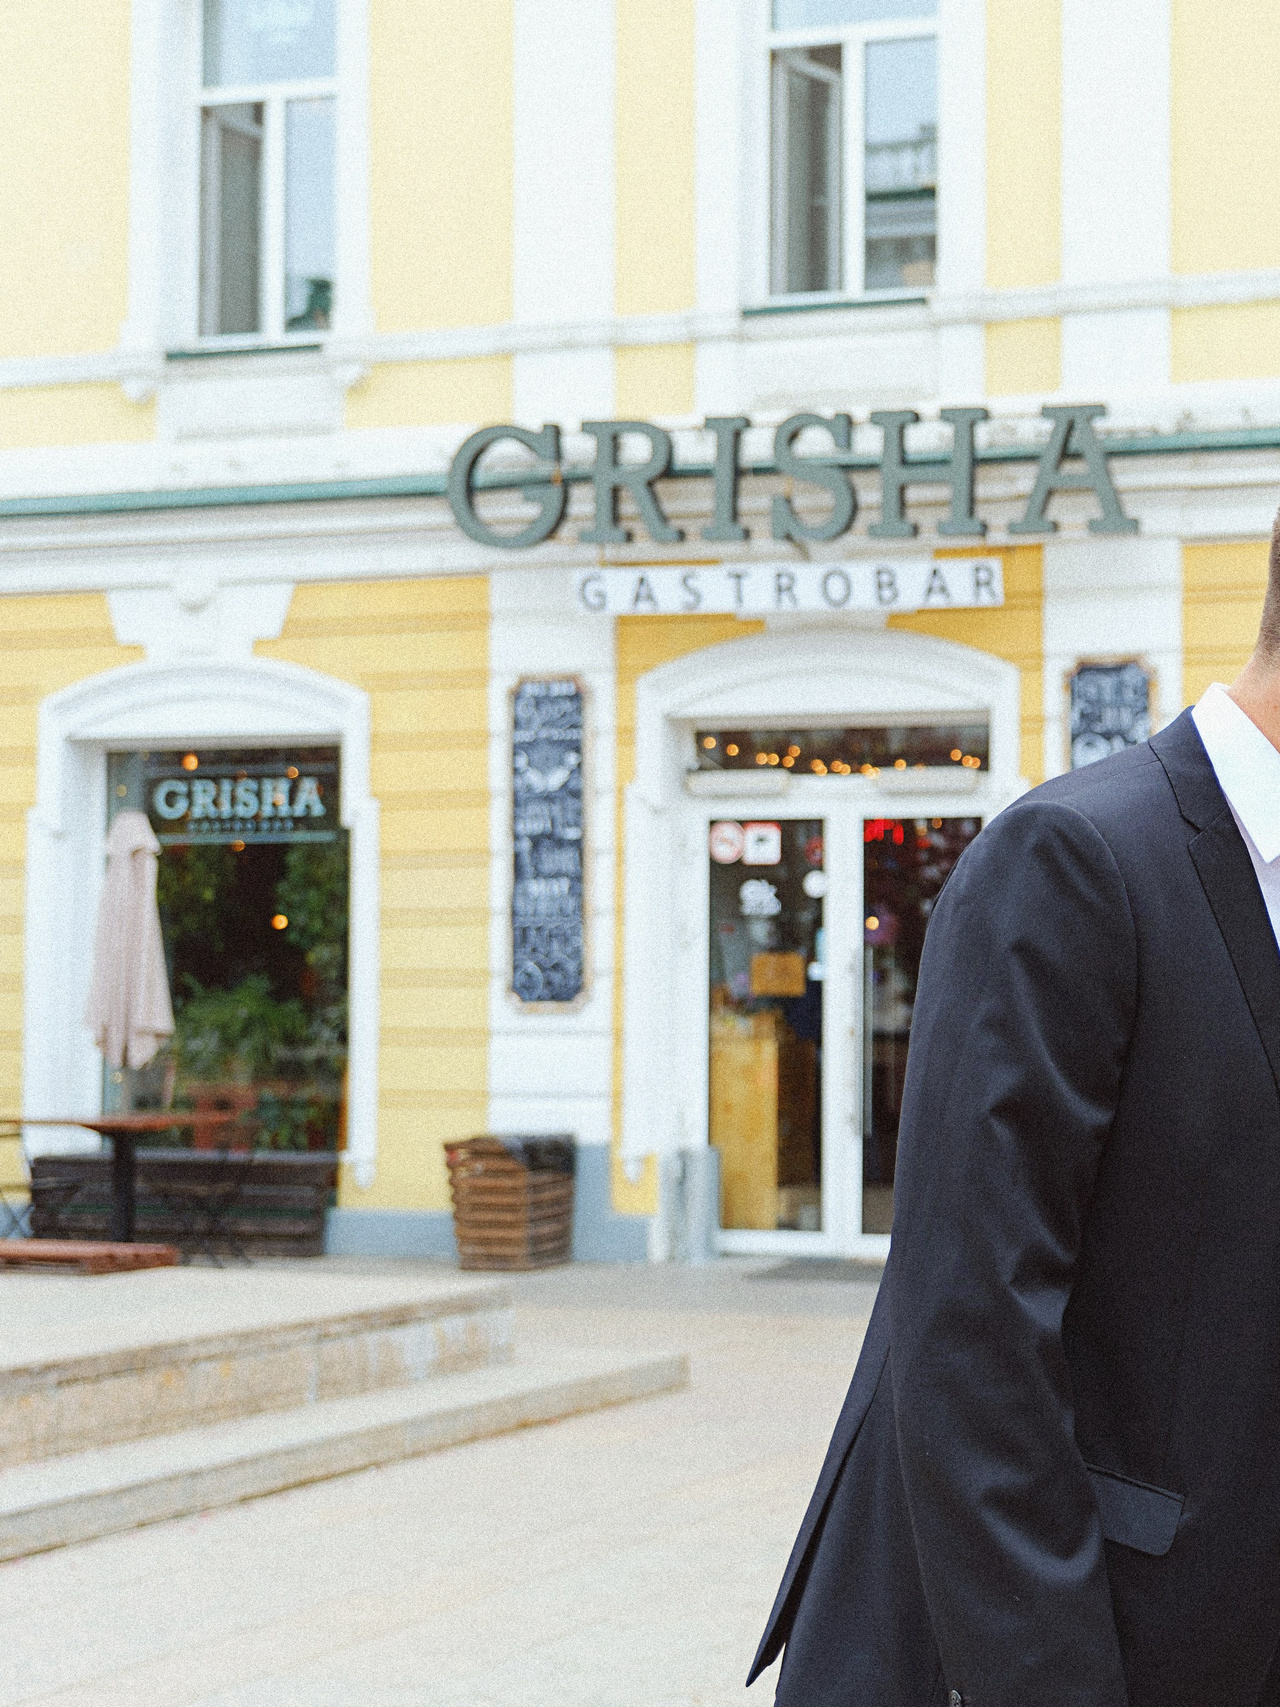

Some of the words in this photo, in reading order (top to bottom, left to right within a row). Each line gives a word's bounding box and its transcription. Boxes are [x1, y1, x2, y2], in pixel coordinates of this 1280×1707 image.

[449, 404, 1139, 549] GRISHA
[579, 564, 999, 614] GASTROBAR
[153, 776, 327, 821] GRISHA
